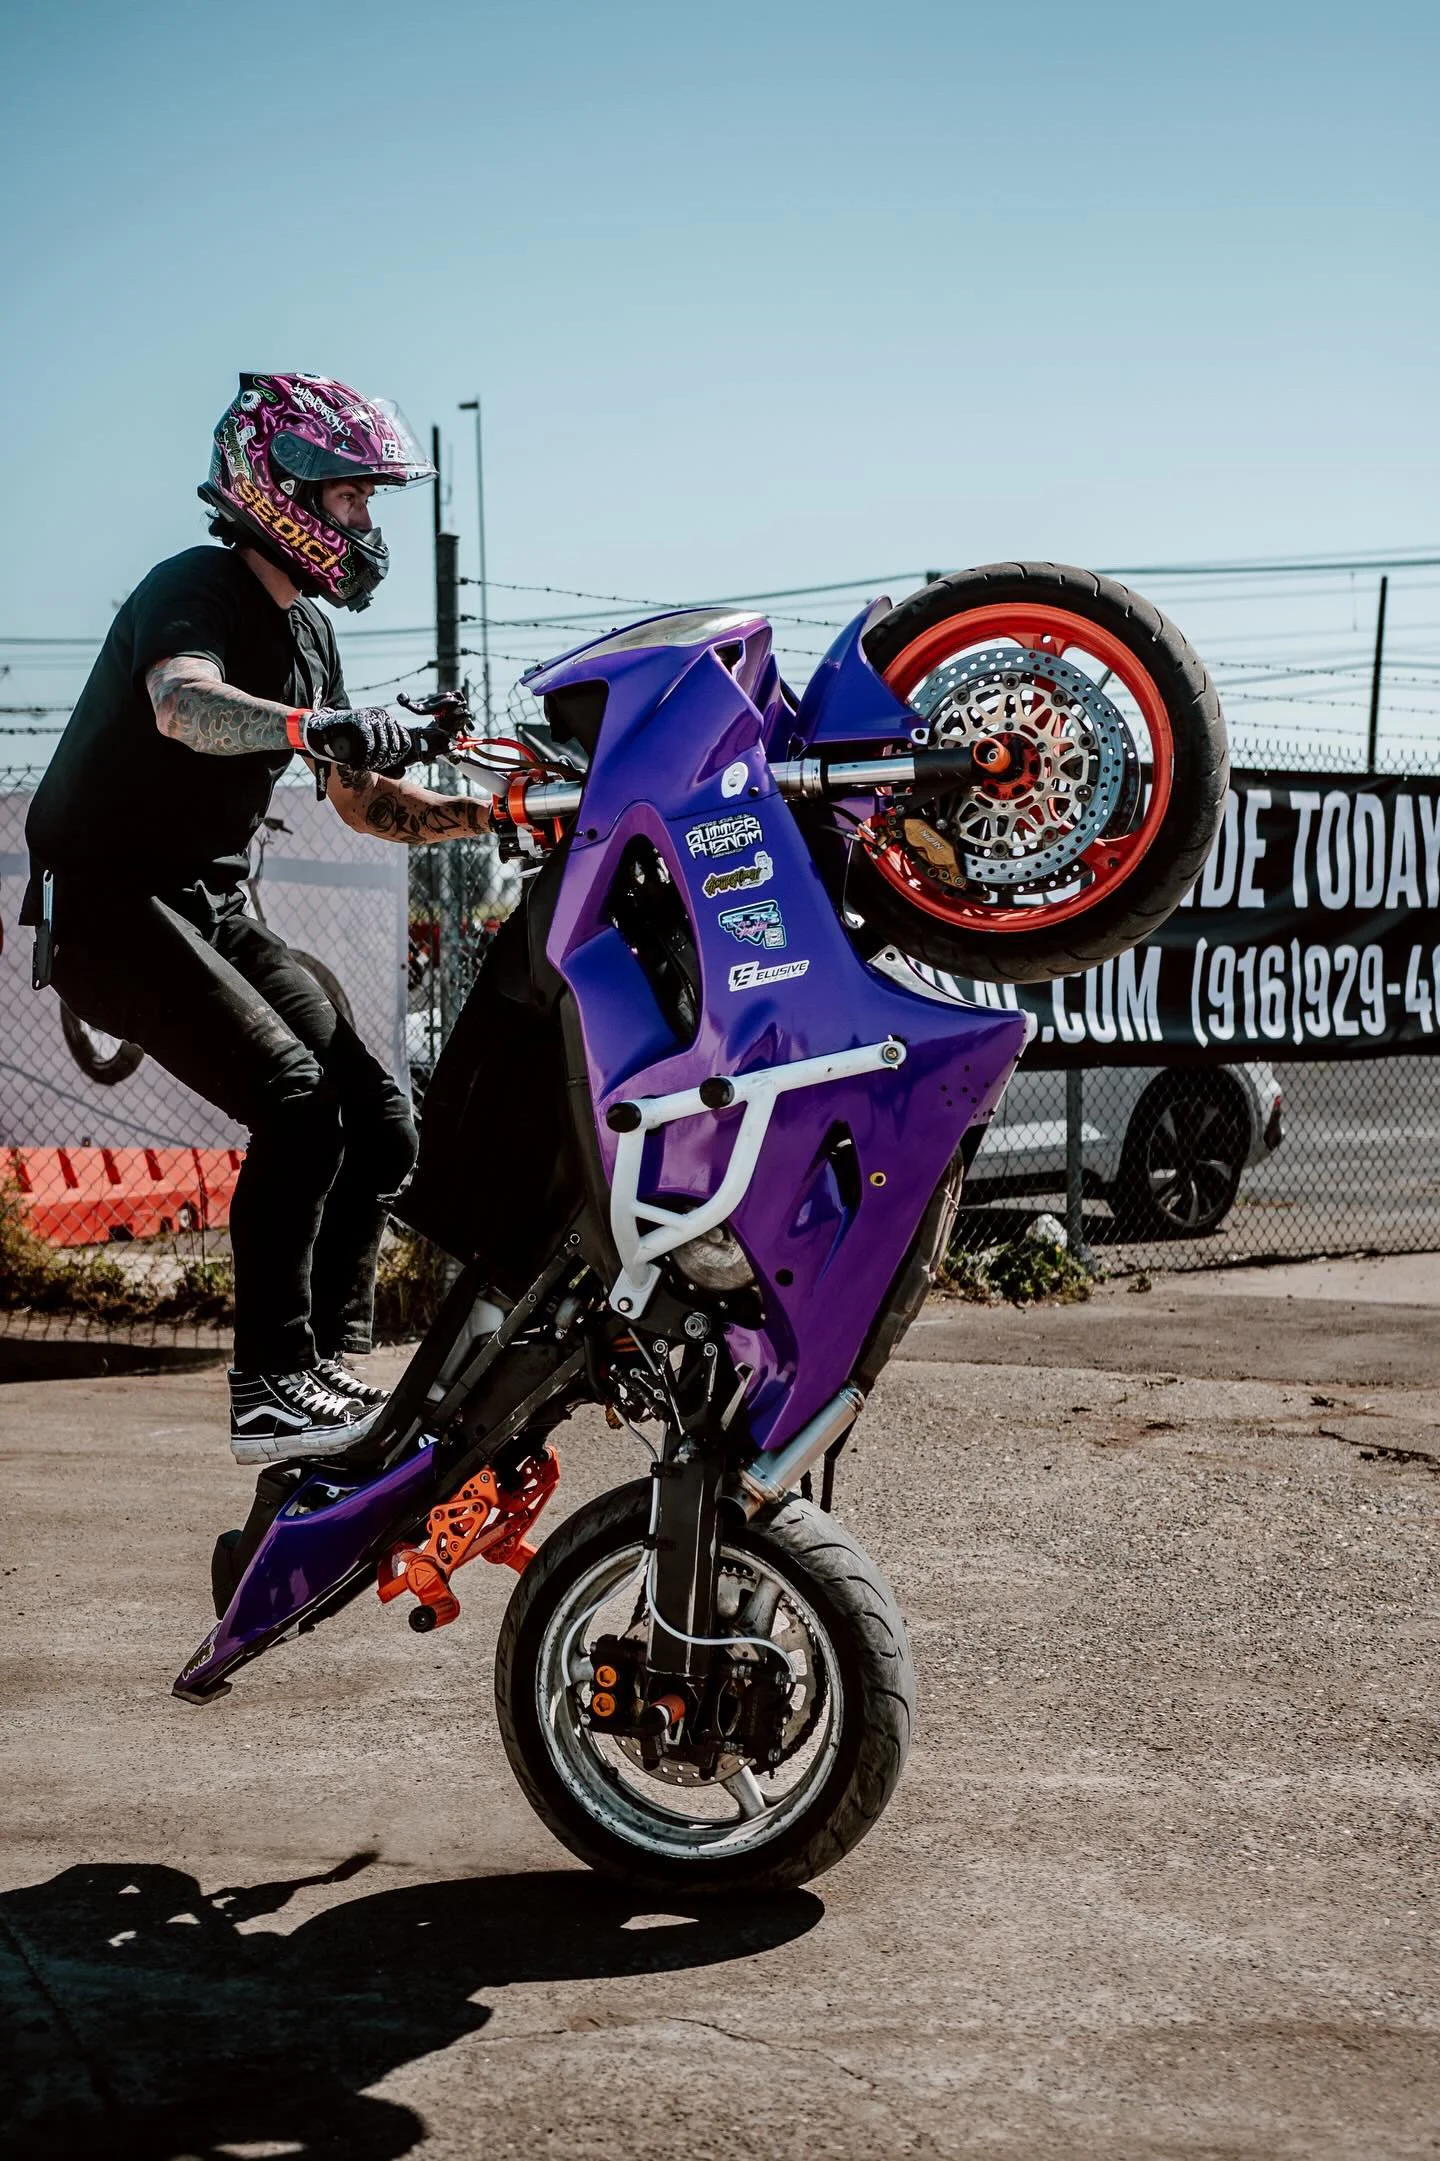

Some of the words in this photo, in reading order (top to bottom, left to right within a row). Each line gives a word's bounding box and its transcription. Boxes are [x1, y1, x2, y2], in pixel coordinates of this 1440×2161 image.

[236, 477, 339, 571] SEDICI
[689, 829, 763, 859] PHENOM
[1180, 789, 1271, 908] DE
[1289, 790, 1440, 910] TODAY
[756, 963, 807, 980] ELUSIVE
[1029, 946, 1163, 1043] .COM
[1191, 937, 1440, 1048] (916)929-4
